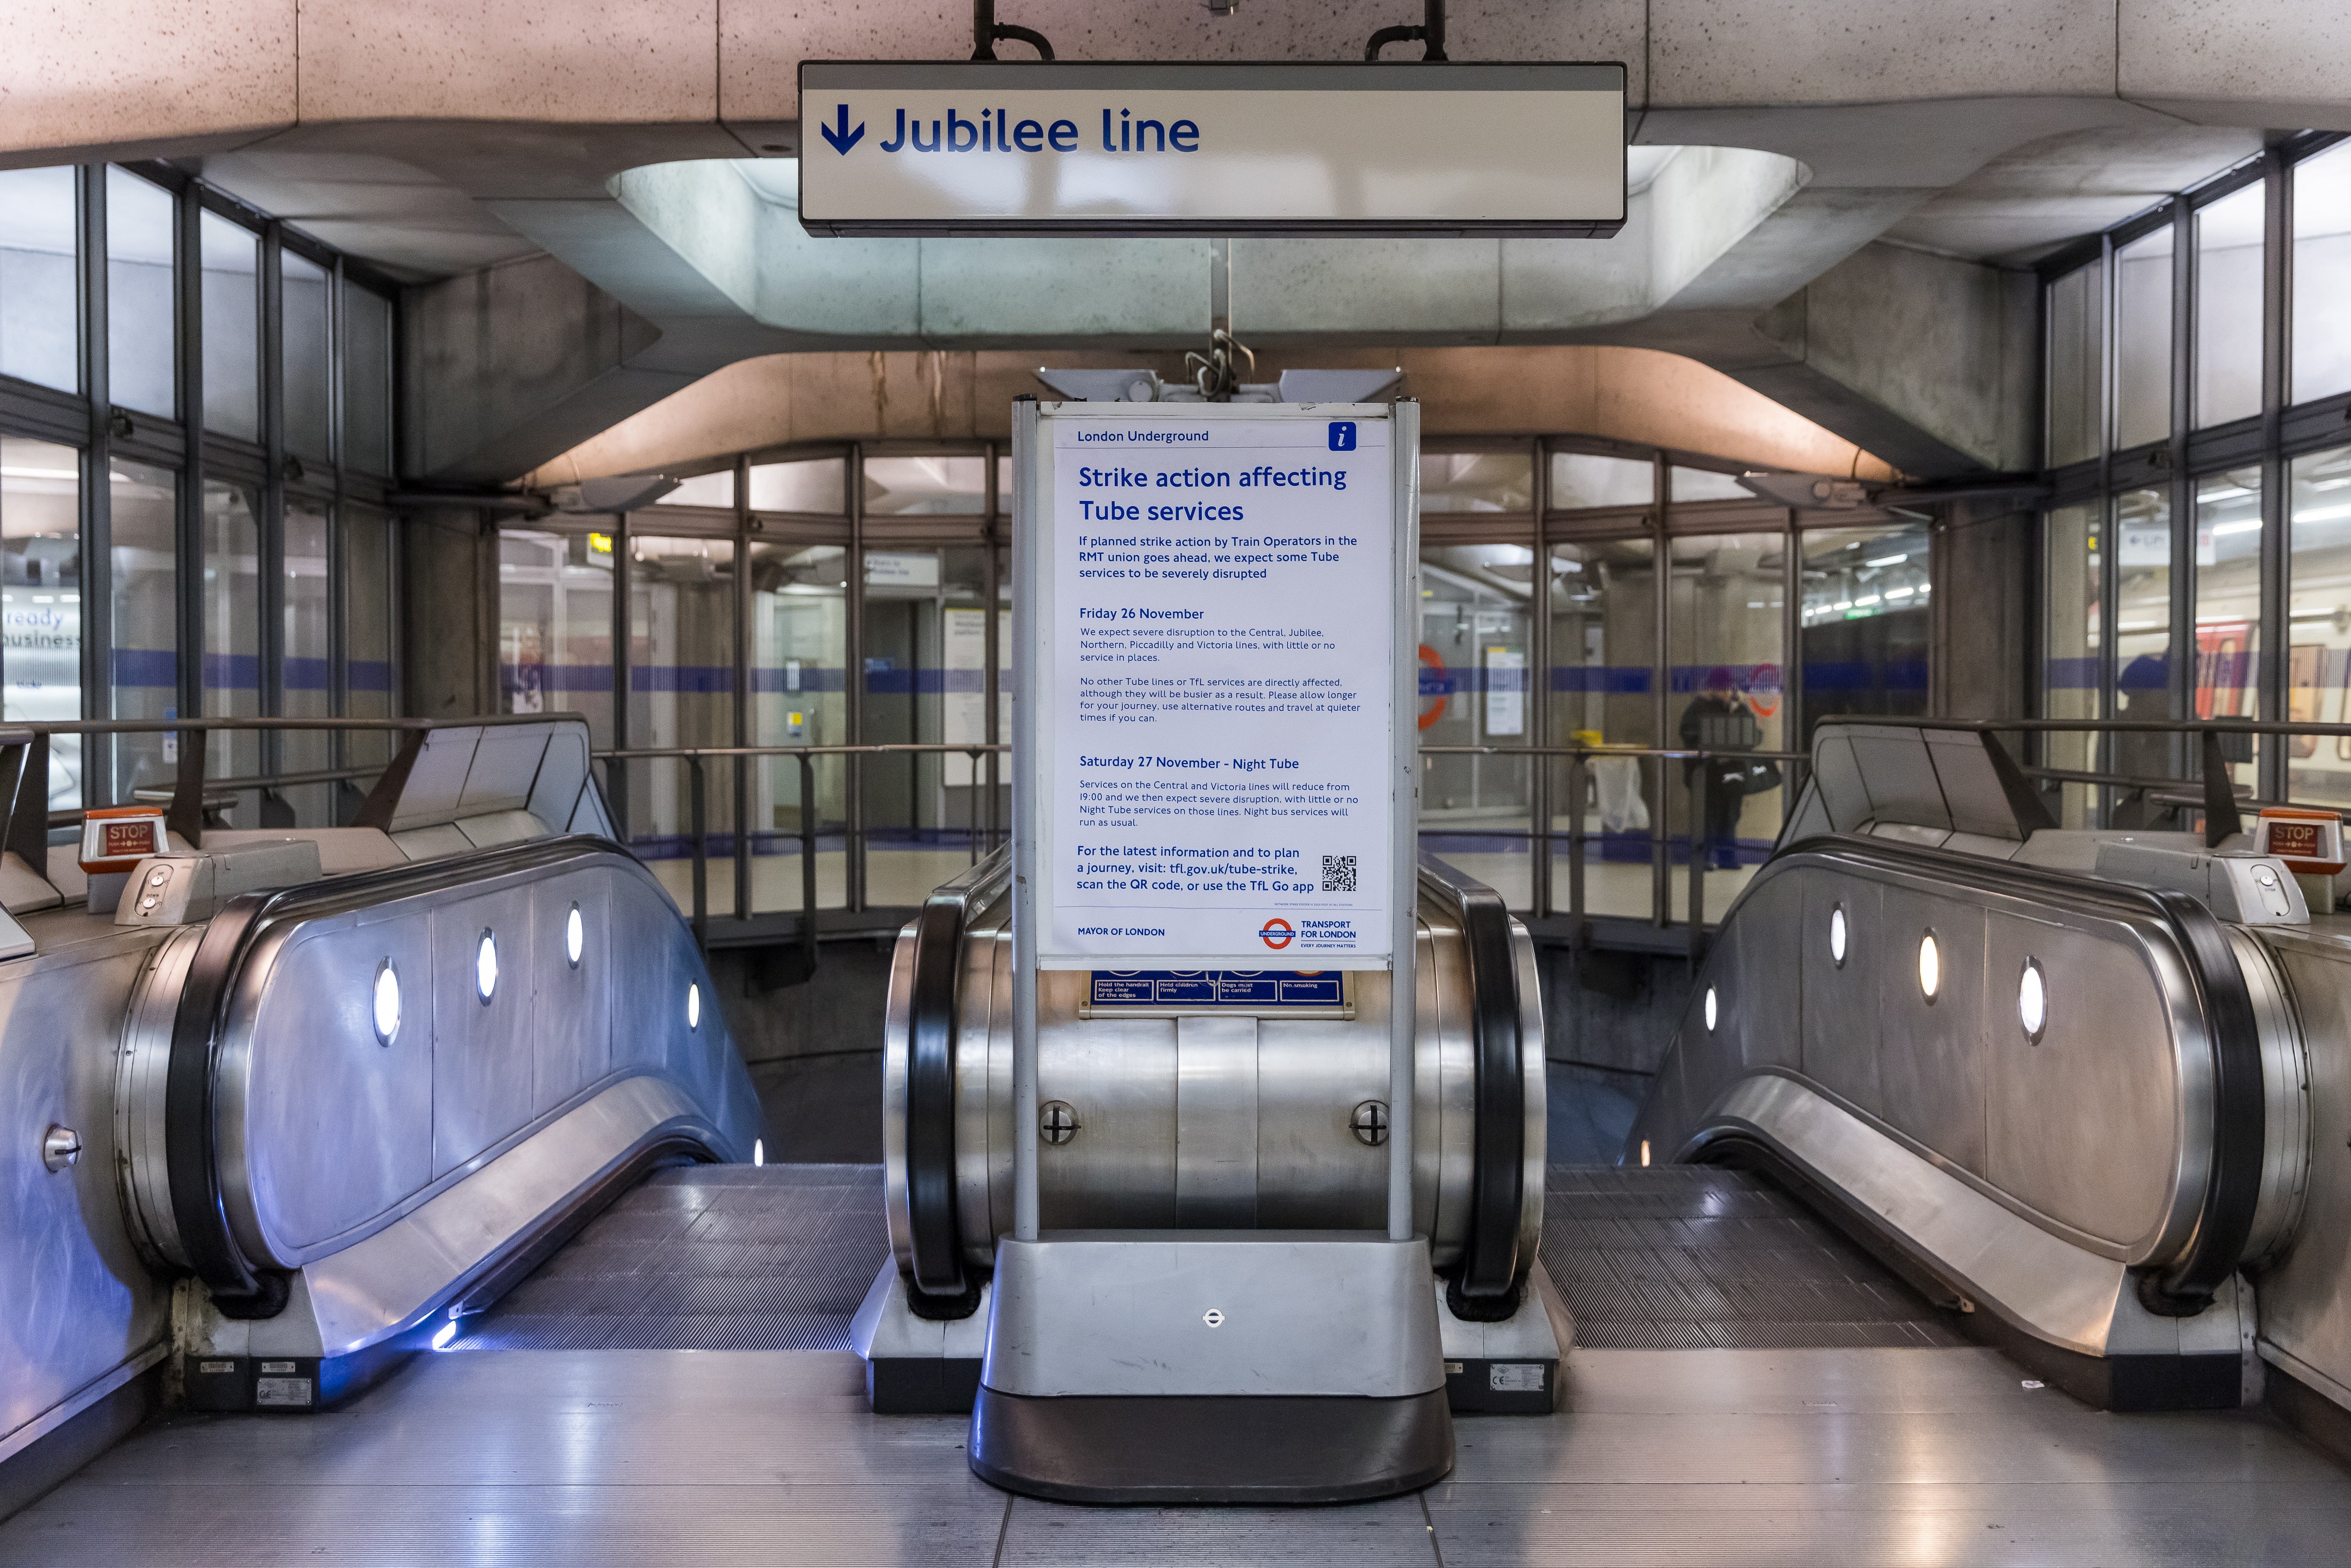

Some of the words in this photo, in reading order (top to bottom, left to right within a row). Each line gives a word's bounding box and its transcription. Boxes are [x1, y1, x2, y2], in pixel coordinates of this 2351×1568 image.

[879, 108, 1079, 153] Jubilee
[1102, 107, 1200, 153] line
[1078, 431, 1124, 442] London
[1128, 430, 1209, 444] Underground
[1079, 466, 1148, 488] Strike
[1156, 467, 1230, 488] action
[1239, 466, 1347, 491] affecting
[1079, 500, 1140, 520] Tube
[1148, 501, 1244, 521] services
[1079, 536, 1088, 546] If
[1091, 536, 1136, 548] planned
[1140, 536, 1172, 547] strike
[1175, 536, 1211, 547] action
[1215, 536, 1228, 549] by
[1231, 536, 1260, 547] Train
[1263, 536, 1321, 549] Operators
[1325, 536, 1335, 545] in
[1338, 536, 1357, 546] the
[1079, 552, 1104, 562] RMT
[1108, 552, 1140, 562] union
[1143, 554, 1170, 565] goes
[1173, 552, 1211, 563] ahead,
[1234, 553, 1273, 565] expect
[1277, 554, 1308, 562] some
[1310, 552, 1339, 562] Tube
[1079, 567, 1125, 578] services
[1128, 569, 1141, 578] to
[1144, 568, 1159, 578] be
[1162, 568, 1209, 581] severely
[1212, 568, 1267, 581] disrupted
[7, 606, 64, 631] ready
[1080, 607, 1117, 621] Friday
[1121, 607, 1136, 619] 26
[1139, 608, 1204, 619] November
[1098, 629, 1130, 638] expect
[1166, 628, 1215, 638] disruption
[1230, 628, 1246, 637] the
[1249, 628, 1286, 637] Central,
[1288, 628, 1324, 637] Jubilee,
[1081, 640, 1127, 649] Northern,
[1130, 640, 1175, 651] Piccadilly
[1236, 641, 1260, 650] lines,
[1262, 641, 1284, 649] with
[1286, 641, 1309, 649] little
[1128, 653, 1160, 663] places.
[1152, 678, 1174, 686] lines
[1265, 678, 1300, 688] directly
[1302, 678, 1342, 687] affected,
[1080, 755, 1134, 770] Saturday
[1138, 756, 1153, 767] 27
[1156, 756, 1221, 769] November
[1233, 758, 1266, 772] Night
[1269, 758, 1299, 769] Tube
[1080, 780, 1118, 788] Services
[1135, 780, 1151, 789] the
[1153, 780, 1189, 790] Central
[1210, 782, 1246, 791] Victoria
[1292, 782, 1324, 791] reduce
[1326, 782, 1350, 791] from
[110, 825, 149, 839] STOP
[2275, 826, 2314, 840] STOP
[1077, 845, 1097, 856] For
[1099, 845, 1120, 856] the
[1123, 845, 1157, 856] latest
[1160, 846, 1229, 858] information
[1232, 847, 1254, 858] and
[1257, 848, 1271, 858] to
[1274, 847, 1300, 860] plan
[1086, 862, 1135, 875] journey,
[1138, 862, 1166, 873] visit:
[1169, 862, 1297, 877] tfl.gov.uk/tube-strike,
[1076, 881, 1103, 890] scan
[1106, 879, 1127, 890] the
[1130, 879, 1148, 890] QR
[1152, 880, 1183, 891] code,
[1187, 882, 1200, 891] or
[1203, 882, 1223, 891] use
[1226, 880, 1247, 891] the
[1249, 880, 1269, 891] TfL
[1272, 881, 1289, 891] Go
[1292, 883, 1314, 894] app
[1301, 920, 1351, 929] TRANSPORT
[1125, 928, 1165, 936] LONDON
